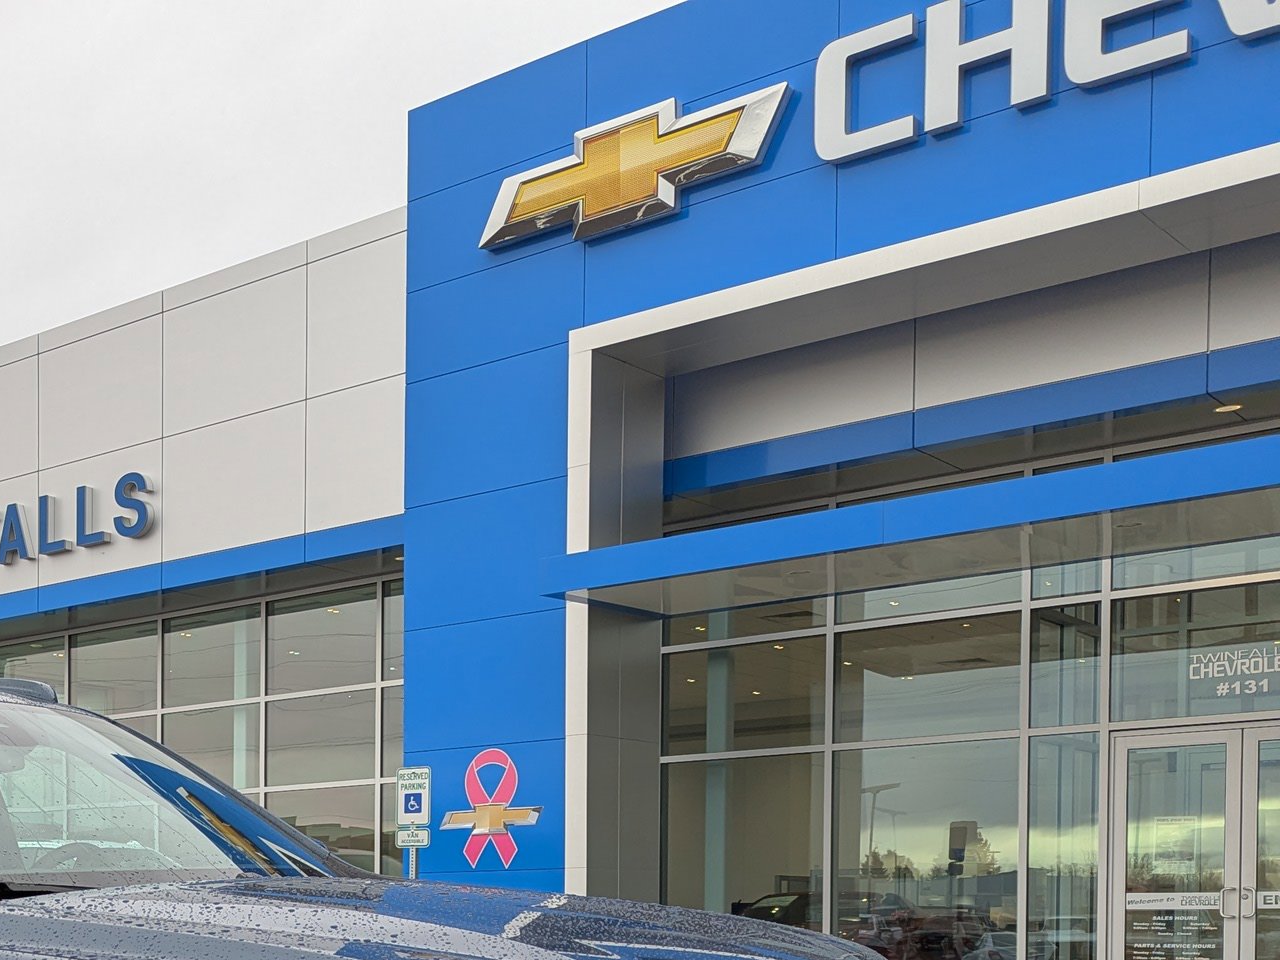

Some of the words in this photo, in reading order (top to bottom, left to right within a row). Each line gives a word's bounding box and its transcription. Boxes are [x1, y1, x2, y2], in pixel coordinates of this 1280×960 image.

[814, 0, 1280, 164] CHE
[1216, 678, 1269, 697] #131
[400, 772, 428, 781] RESERVED
[401, 783, 426, 791] PARKING
